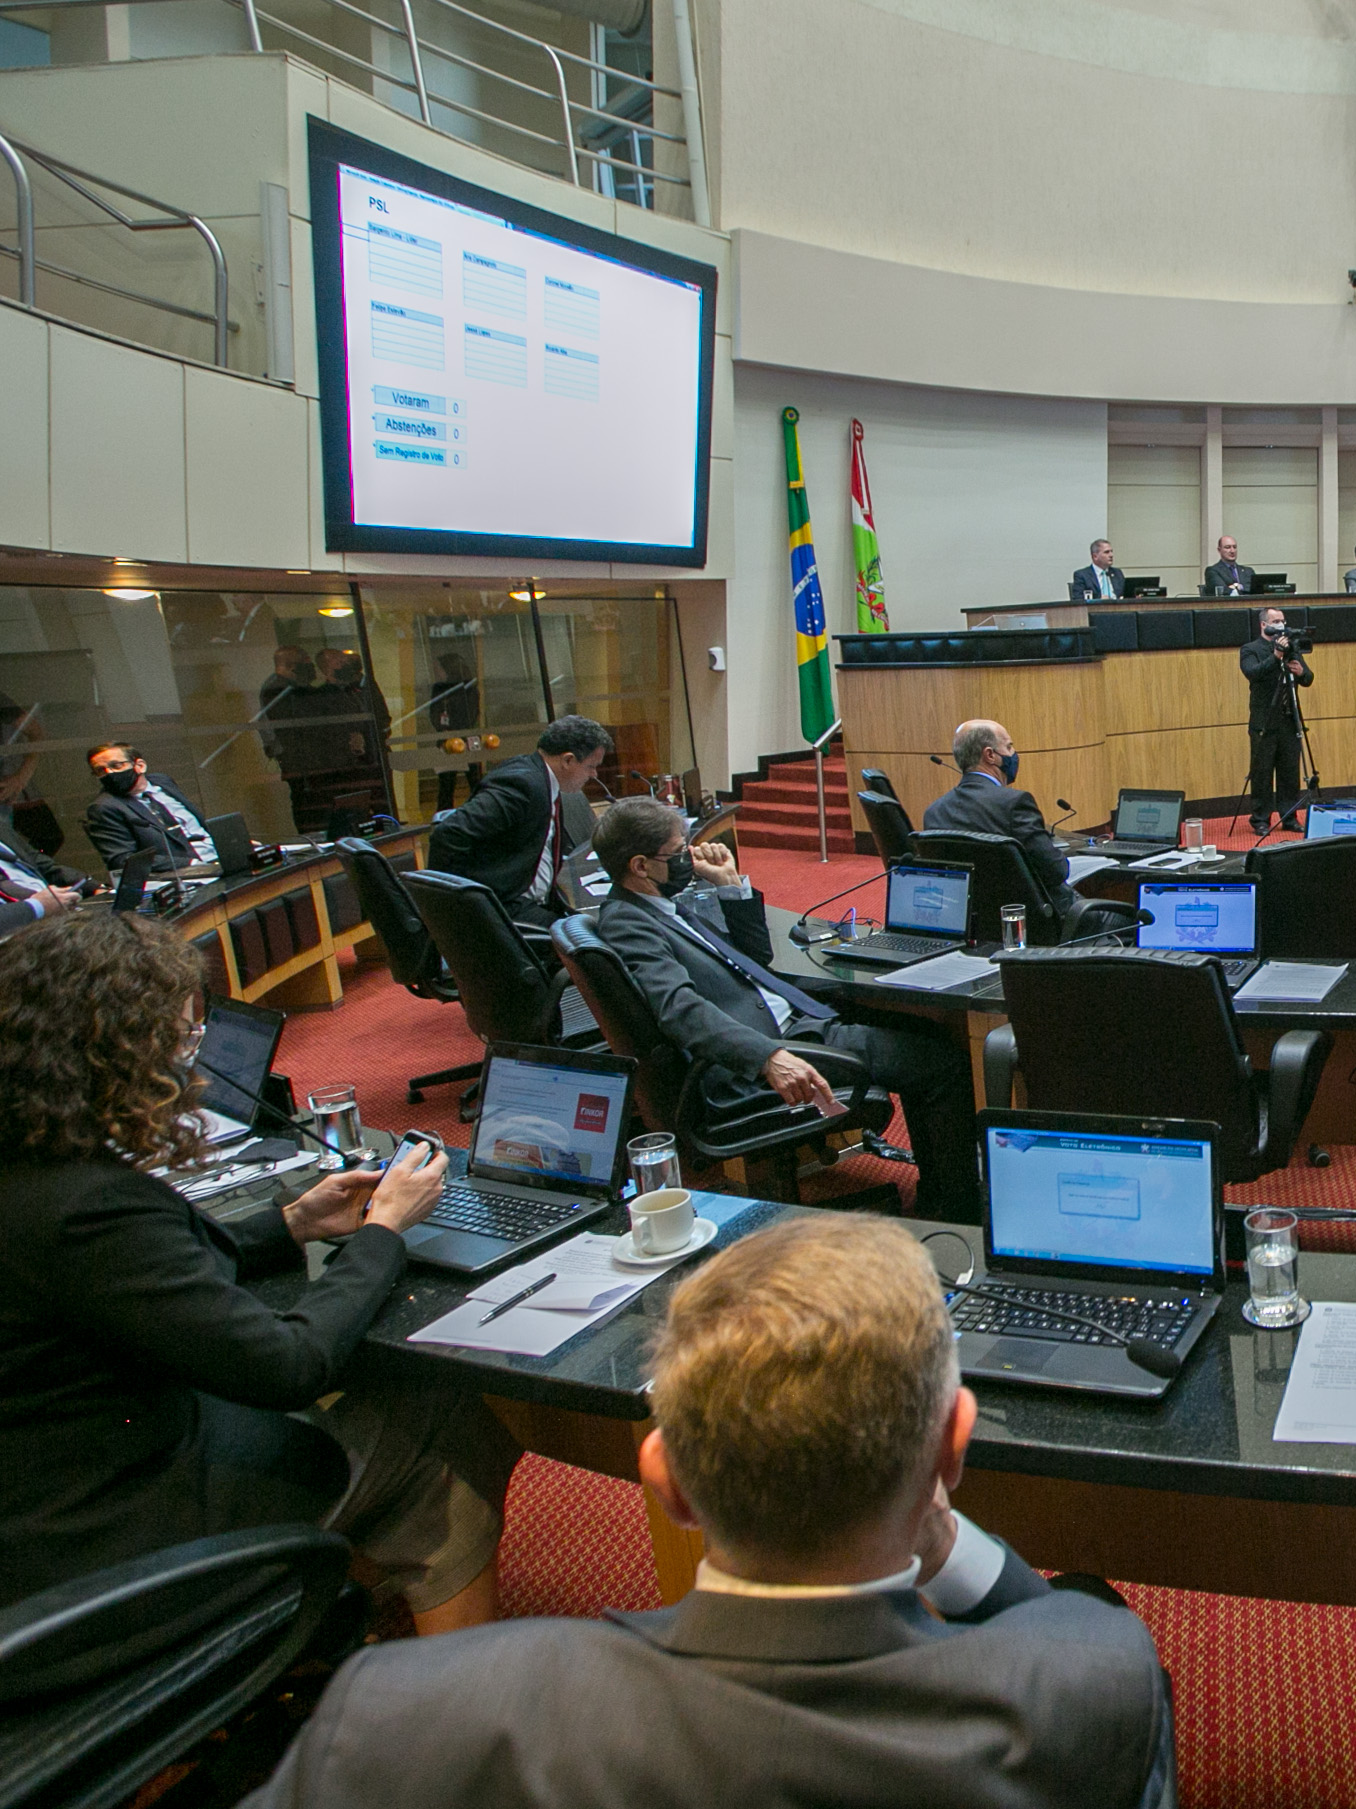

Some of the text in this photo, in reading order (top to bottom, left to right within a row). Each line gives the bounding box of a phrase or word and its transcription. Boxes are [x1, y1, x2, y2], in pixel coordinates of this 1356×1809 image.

[369, 196, 389, 214] PSL
[392, 391, 459, 414] Votaram 0
[386, 418, 459, 439] Abstenções 0
[379, 445, 459, 465] Sem Registro de Voto 0
